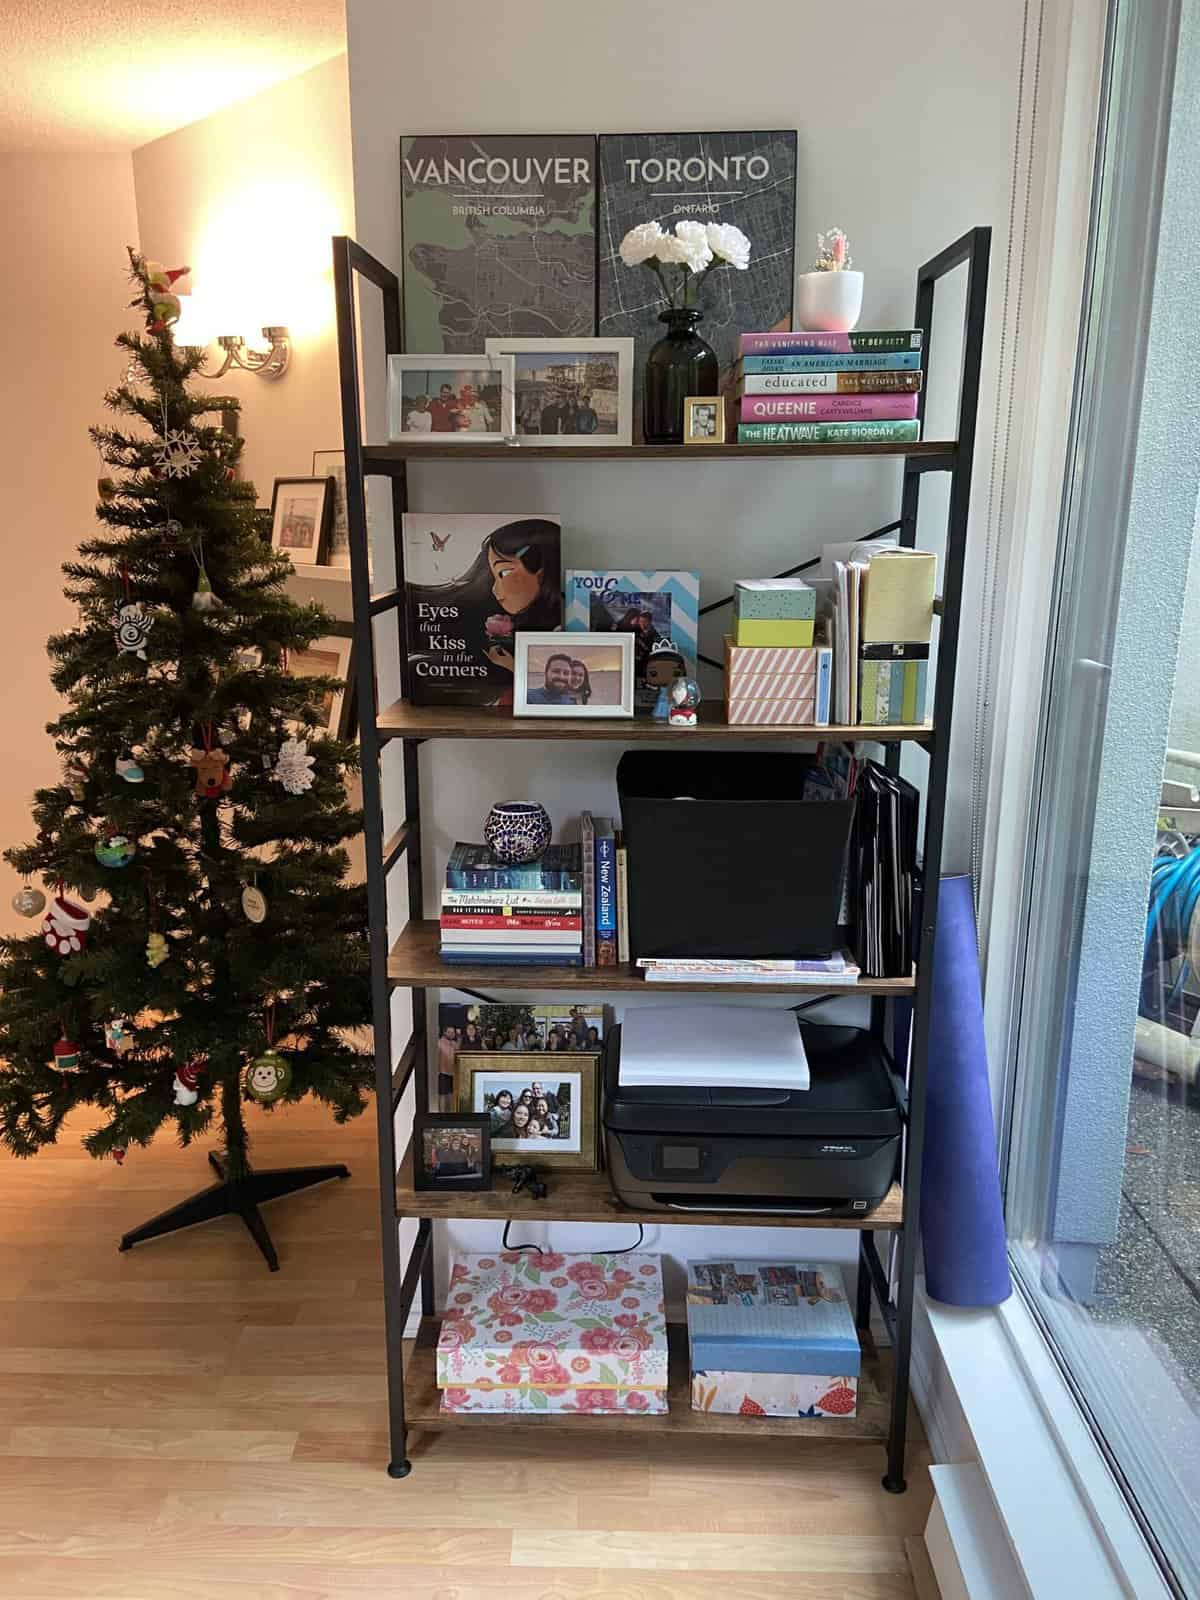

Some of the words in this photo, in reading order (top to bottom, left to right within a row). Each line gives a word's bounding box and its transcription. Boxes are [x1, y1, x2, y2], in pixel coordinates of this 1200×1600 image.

[404, 158, 591, 185] VANCOUVER
[625, 156, 770, 184] TORONTO
[452, 206, 490, 216] BRITISH
[492, 205, 546, 216] COLUMBIA
[673, 203, 720, 214] ONTARIO
[764, 375, 828, 388] educated
[753, 401, 817, 417] QUEENIE
[745, 430, 761, 439] THE
[763, 426, 820, 441] HEATWAVE
[827, 428, 849, 438] KATE
[851, 427, 894, 437] RIORDAN
[573, 576, 604, 589] YOU
[417, 603, 459, 621] Eyes
[419, 621, 441, 632] that
[428, 634, 466, 650] Kiss
[443, 652, 454, 662] in
[456, 651, 474, 662] the
[415, 661, 488, 677] Corners
[600, 861, 611, 883] New
[600, 886, 612, 925] Zealand
